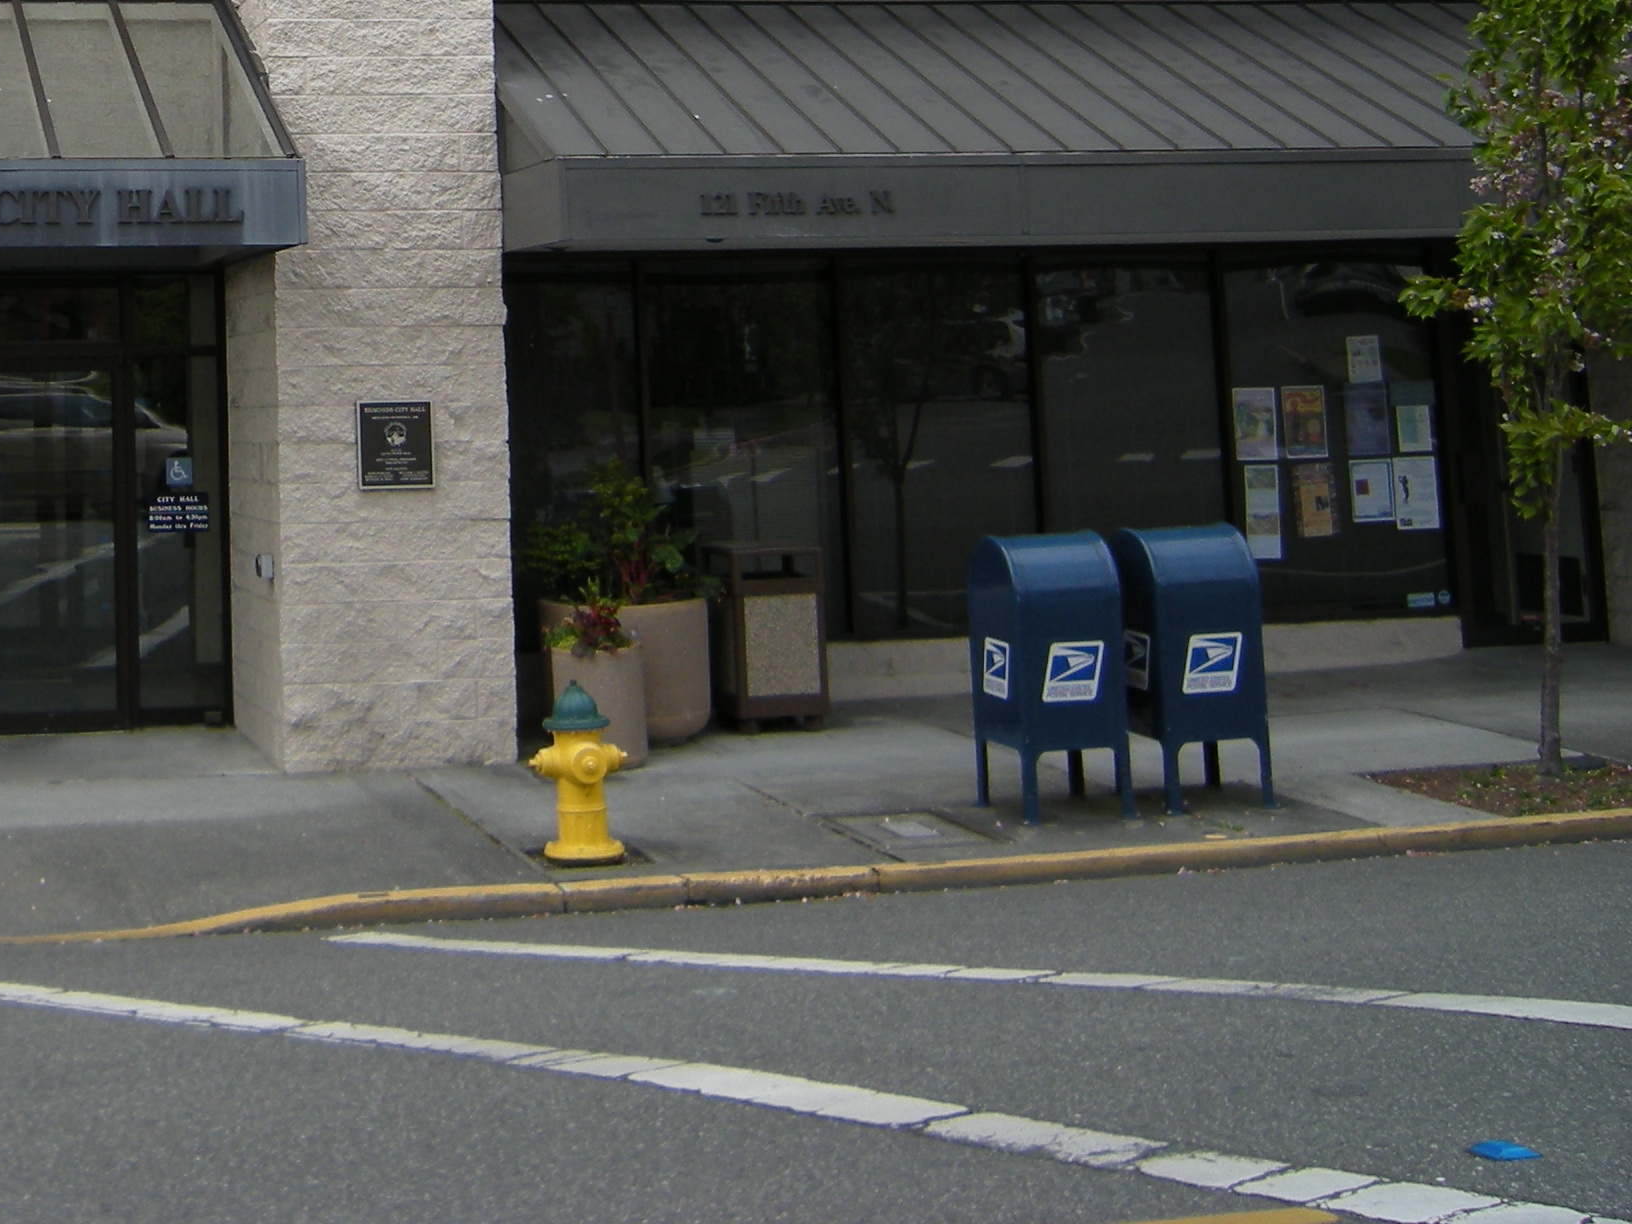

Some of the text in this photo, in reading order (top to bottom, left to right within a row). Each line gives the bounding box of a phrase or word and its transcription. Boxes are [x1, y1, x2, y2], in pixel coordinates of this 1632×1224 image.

[117, 188, 245, 225] HALL
[699, 192, 738, 216] 121
[747, 191, 805, 216] Fifth
[869, 190, 895, 215] N
